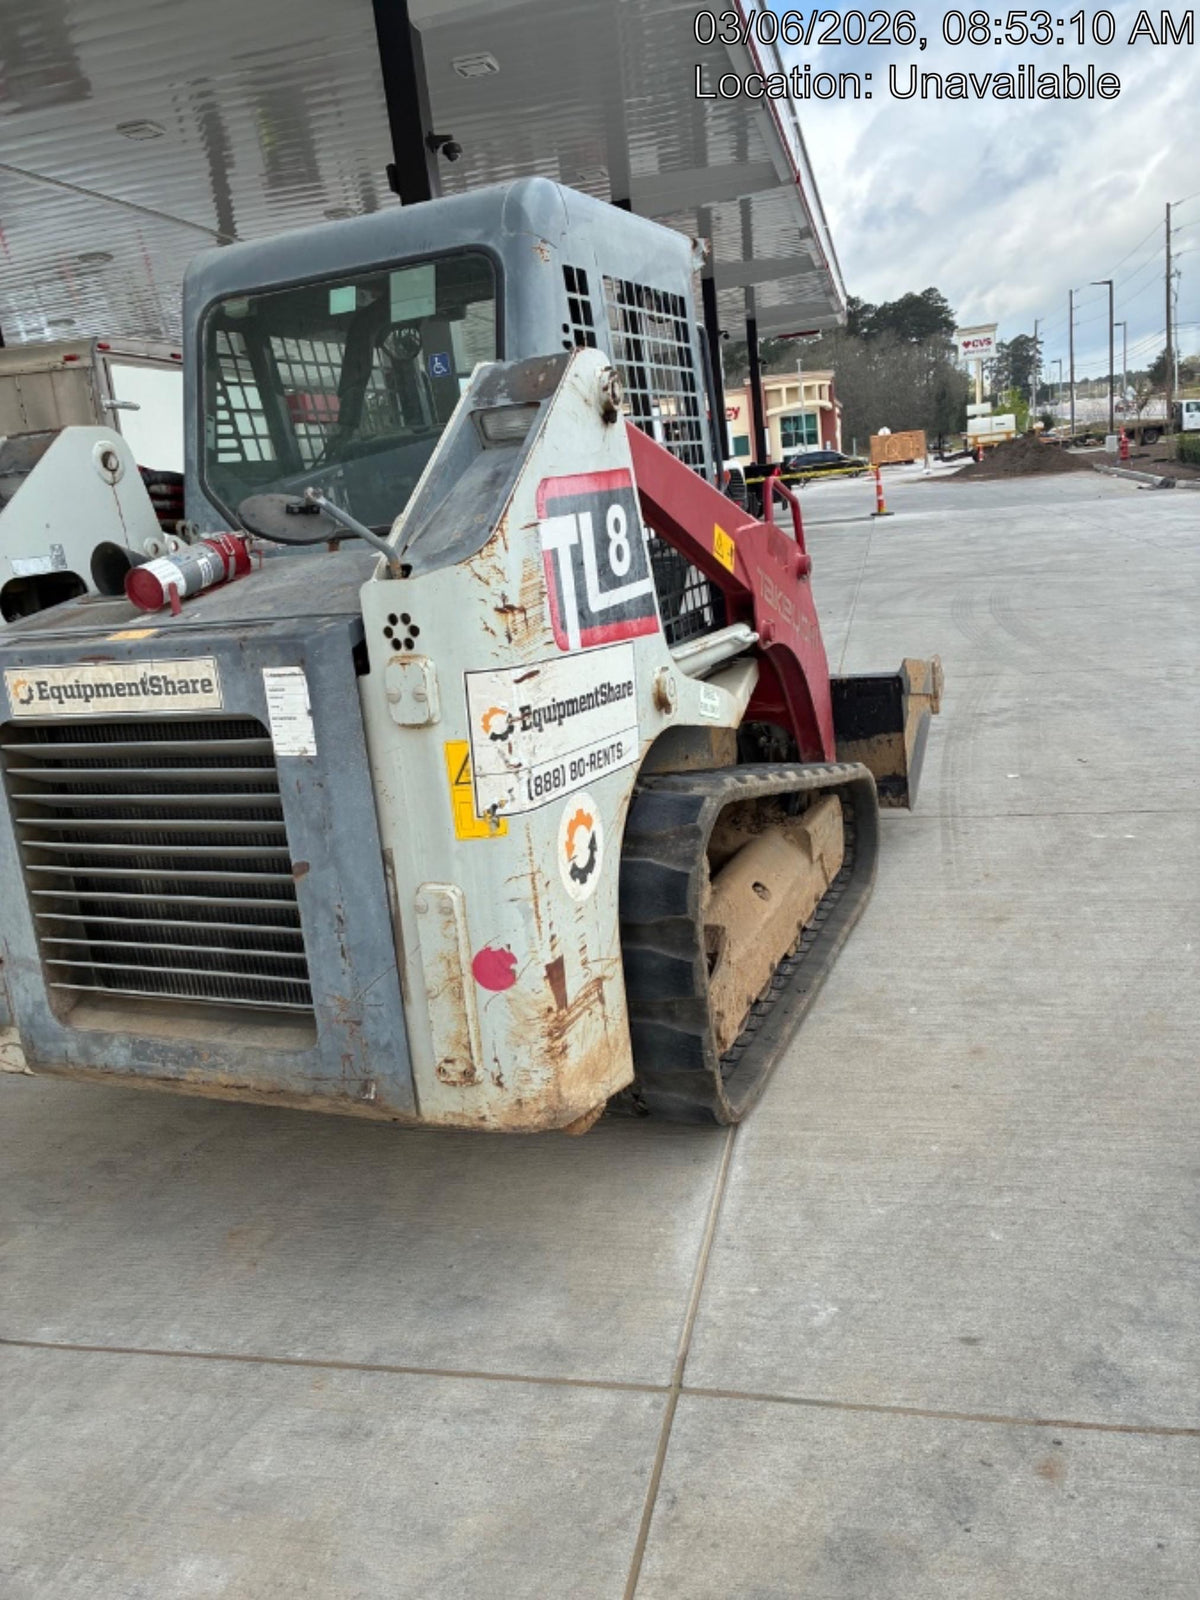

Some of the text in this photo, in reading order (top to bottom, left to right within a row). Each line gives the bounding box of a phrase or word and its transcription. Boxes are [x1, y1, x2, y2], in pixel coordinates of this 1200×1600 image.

[972, 337, 992, 347] CVS
[35, 672, 214, 704] EquipmentShare
[518, 680, 633, 732] EquipmentShare
[527, 764, 565, 801] (888)
